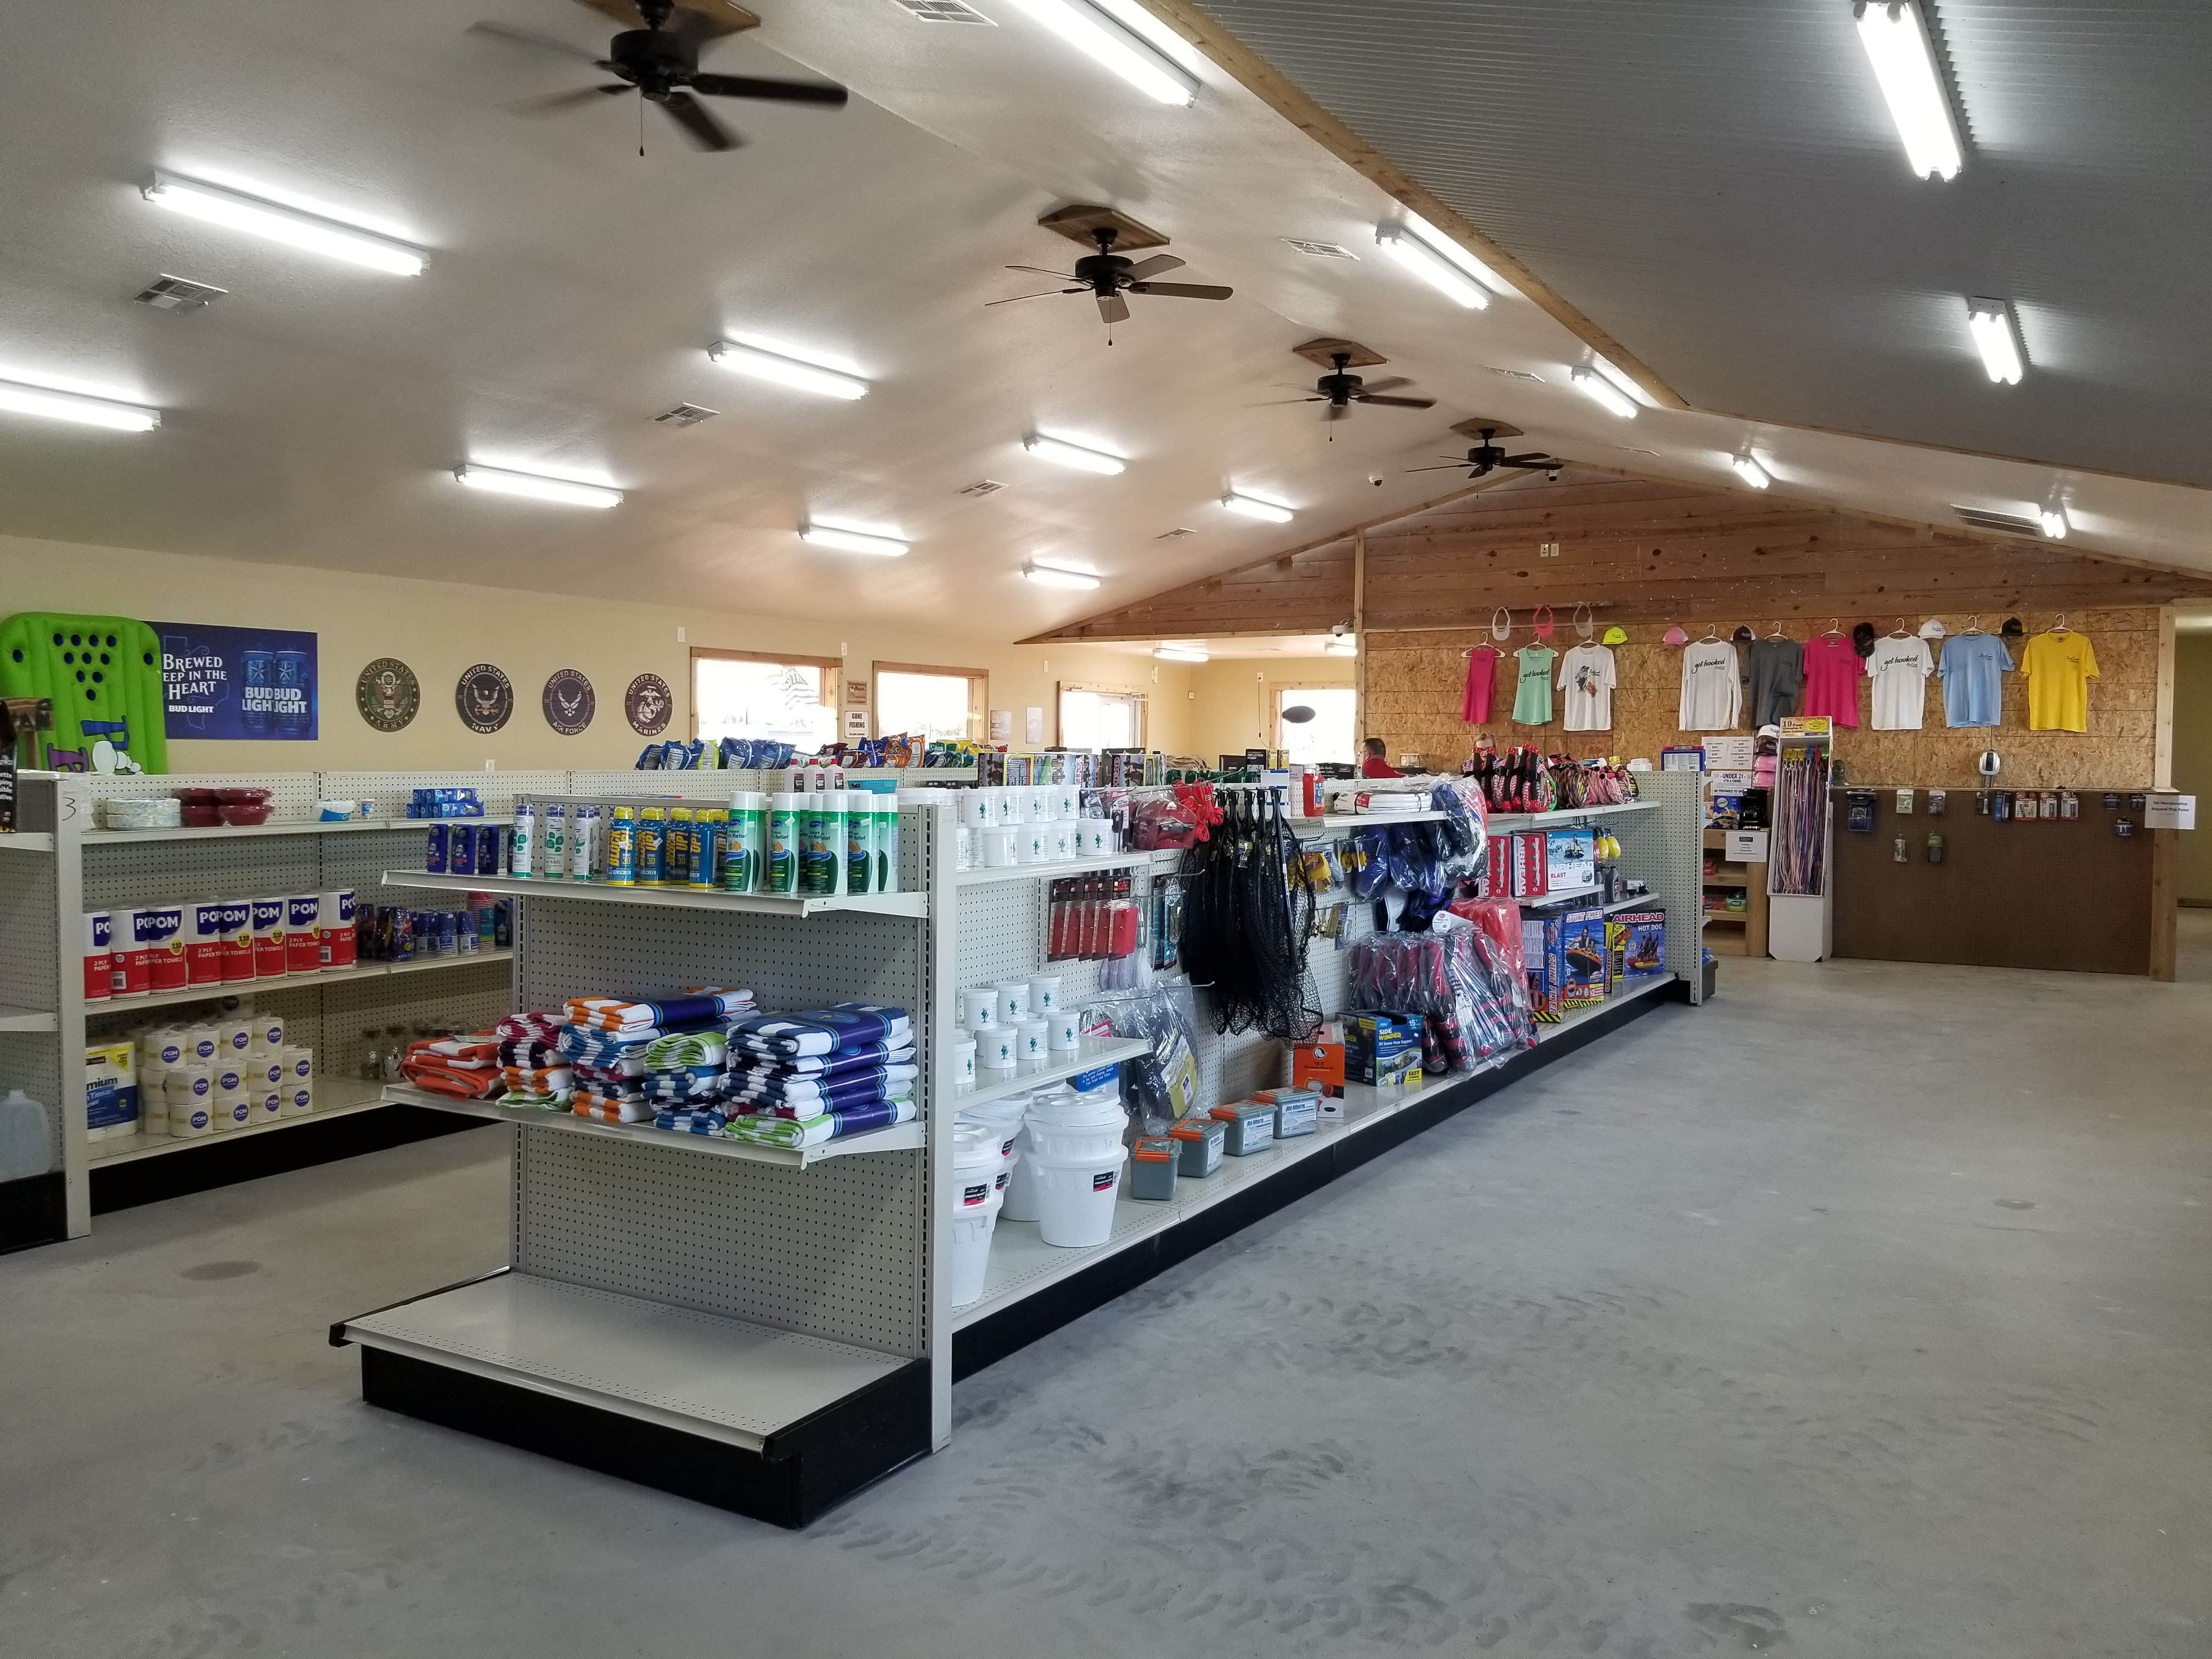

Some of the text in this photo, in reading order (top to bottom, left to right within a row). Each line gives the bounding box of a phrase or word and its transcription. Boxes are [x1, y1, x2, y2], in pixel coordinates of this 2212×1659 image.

[163, 653, 223, 672] BREWED
[1691, 657, 1726, 674] get hooked
[1880, 654, 1918, 672] get hooked
[163, 670, 228, 682] EEP IN THE
[362, 661, 388, 684] UNITED
[461, 665, 510, 689] UNITED STATES
[1520, 669, 1550, 684] get hooked
[548, 670, 591, 691] UNITED STATES
[629, 675, 670, 698] UNITED STATES
[168, 681, 217, 700] HEART
[245, 687, 273, 699] BUD
[274, 688, 301, 701] BUD
[168, 705, 215, 714] BUD LIGHT
[242, 698, 273, 712] LIGH
[375, 719, 403, 730] ARMY
[472, 723, 499, 733] NAVY
[552, 721, 588, 734] AIR FORCE
[632, 721, 667, 735] MARINES
[63, 797, 76, 821] 3
[622, 857, 630, 865] 30
[253, 907, 279, 918] POM
[291, 902, 318, 915] POM
[148, 916, 178, 929] POM
[200, 911, 217, 923] PO
[217, 910, 246, 922] POM
[1566, 910, 1602, 923] STUNT FLYER
[1612, 912, 1664, 923] AIRHEAD
[96, 922, 110, 934] PO
[1548, 952, 1558, 1015] STUNT FLYER
[1379, 1032, 1401, 1041] WINDER
[87, 1076, 118, 1091] mium
